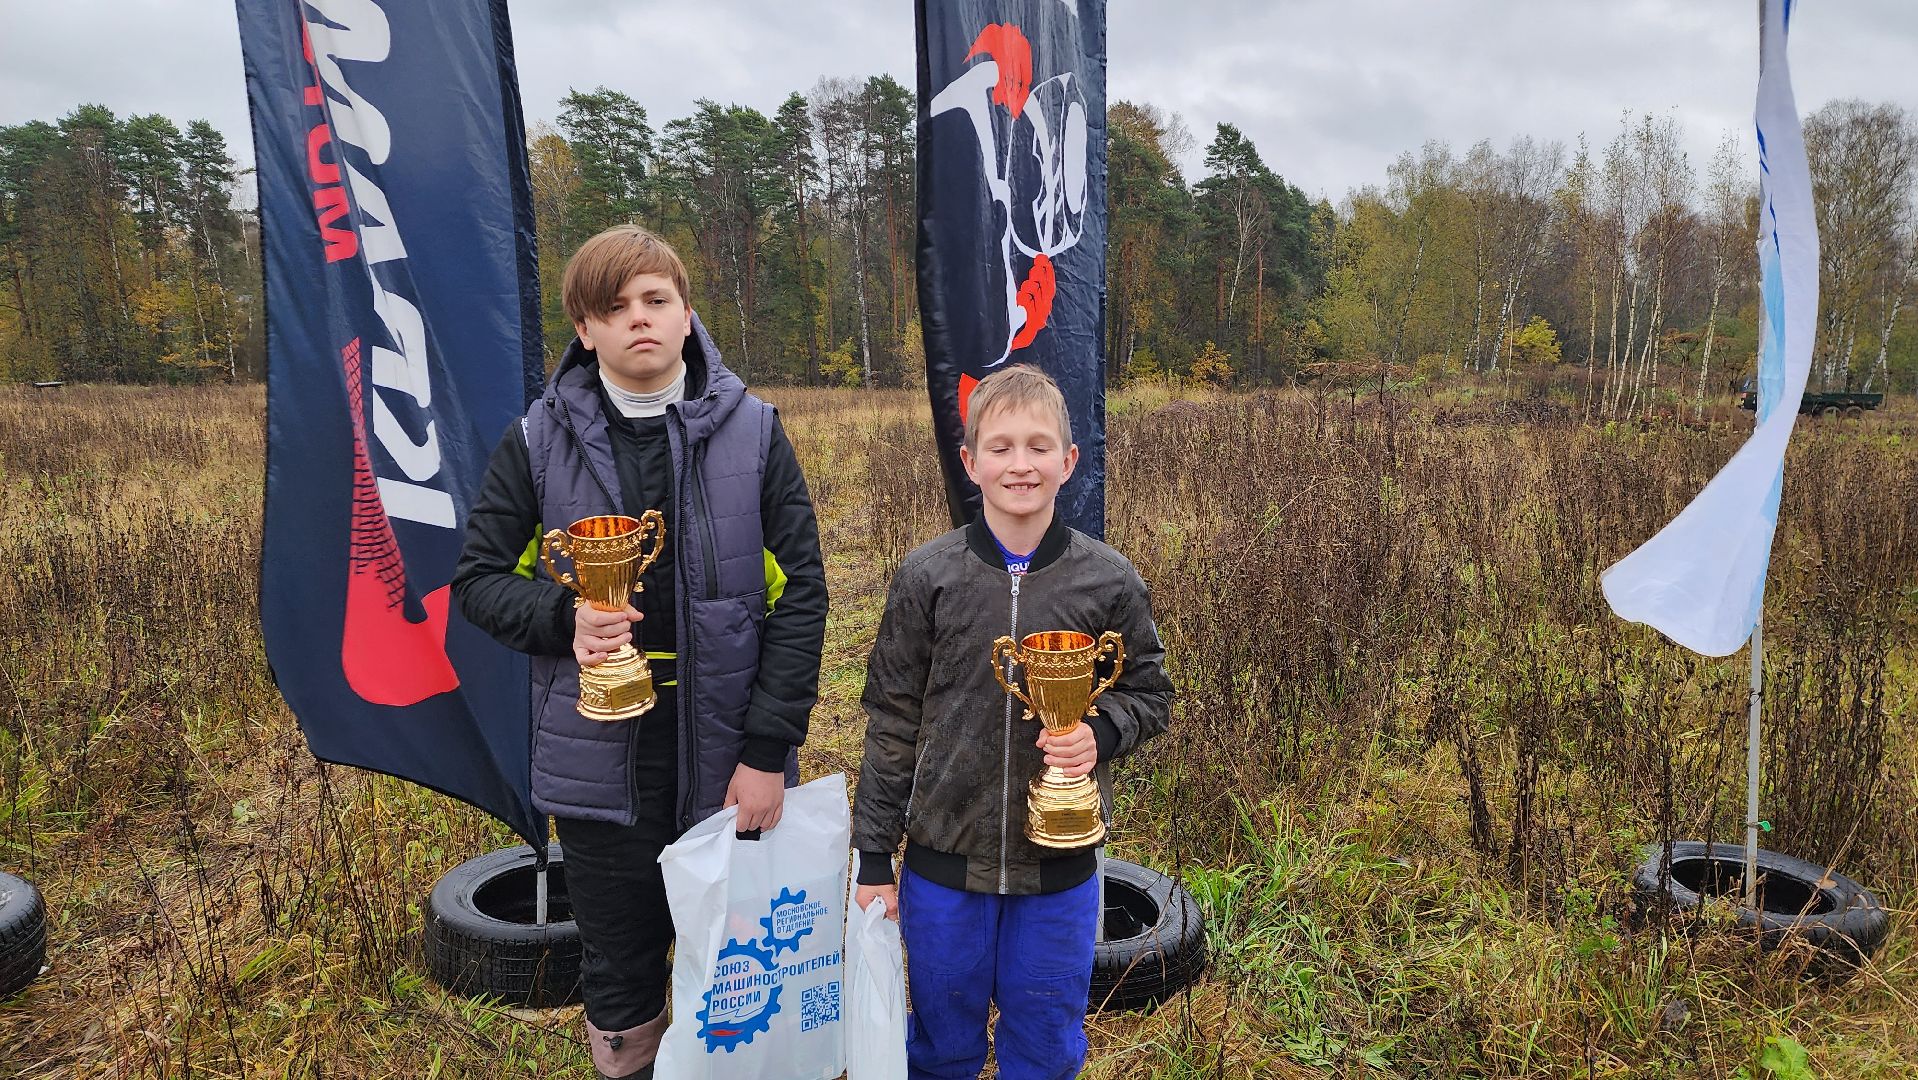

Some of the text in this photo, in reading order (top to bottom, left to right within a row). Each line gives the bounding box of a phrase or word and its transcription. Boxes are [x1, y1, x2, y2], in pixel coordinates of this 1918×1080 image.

[776, 901, 821, 918] МОСКОВСКОЕ
[777, 907, 828, 926] РЕГИОНАЛЬНОЕ
[777, 918, 815, 933] ОТДЕЛЕНИЕ
[712, 950, 840, 995] МАШИНОСТРОИТЕЛЕЙ
[714, 961, 749, 978] СОЮЗ
[713, 991, 761, 1012] РОССИИ
